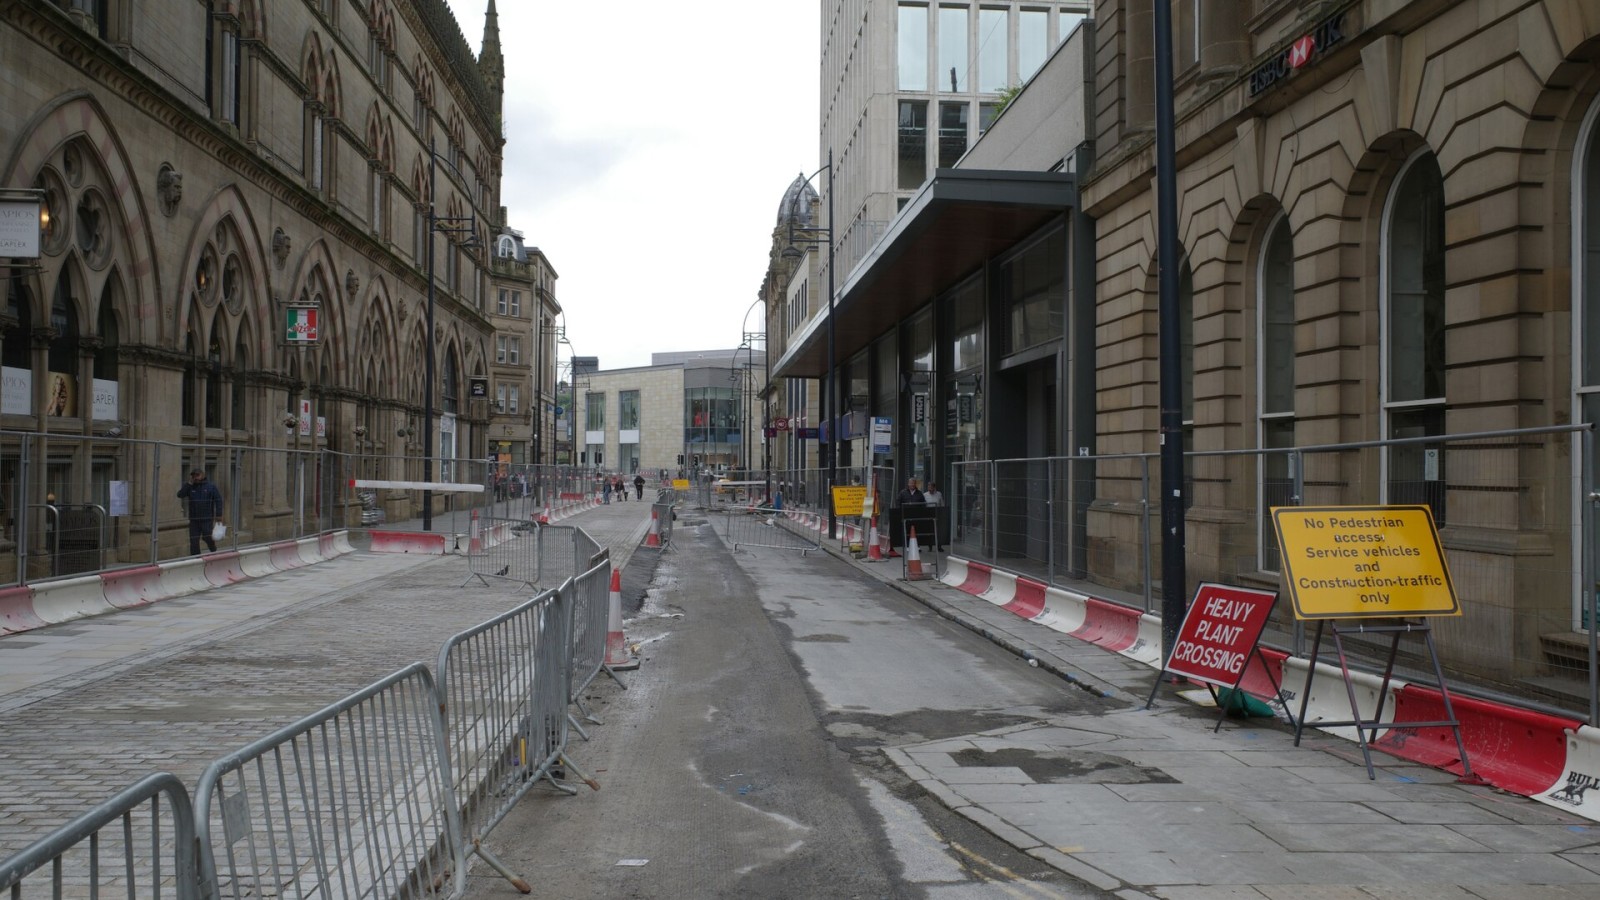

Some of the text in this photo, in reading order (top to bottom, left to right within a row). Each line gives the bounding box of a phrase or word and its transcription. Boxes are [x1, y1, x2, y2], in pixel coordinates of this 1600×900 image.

[1249, 16, 1345, 96] HSBC UK
[1304, 517, 1404, 529] No Pedestrian
[1306, 545, 1420, 559] Service vehicles
[1355, 561, 1380, 572] and
[1360, 592, 1390, 604] only
[1203, 596, 1256, 622] HEAVY
[1194, 620, 1244, 646] PLANT
[1174, 640, 1245, 674] CROSSING
[1566, 770, 1600, 791] BULL
